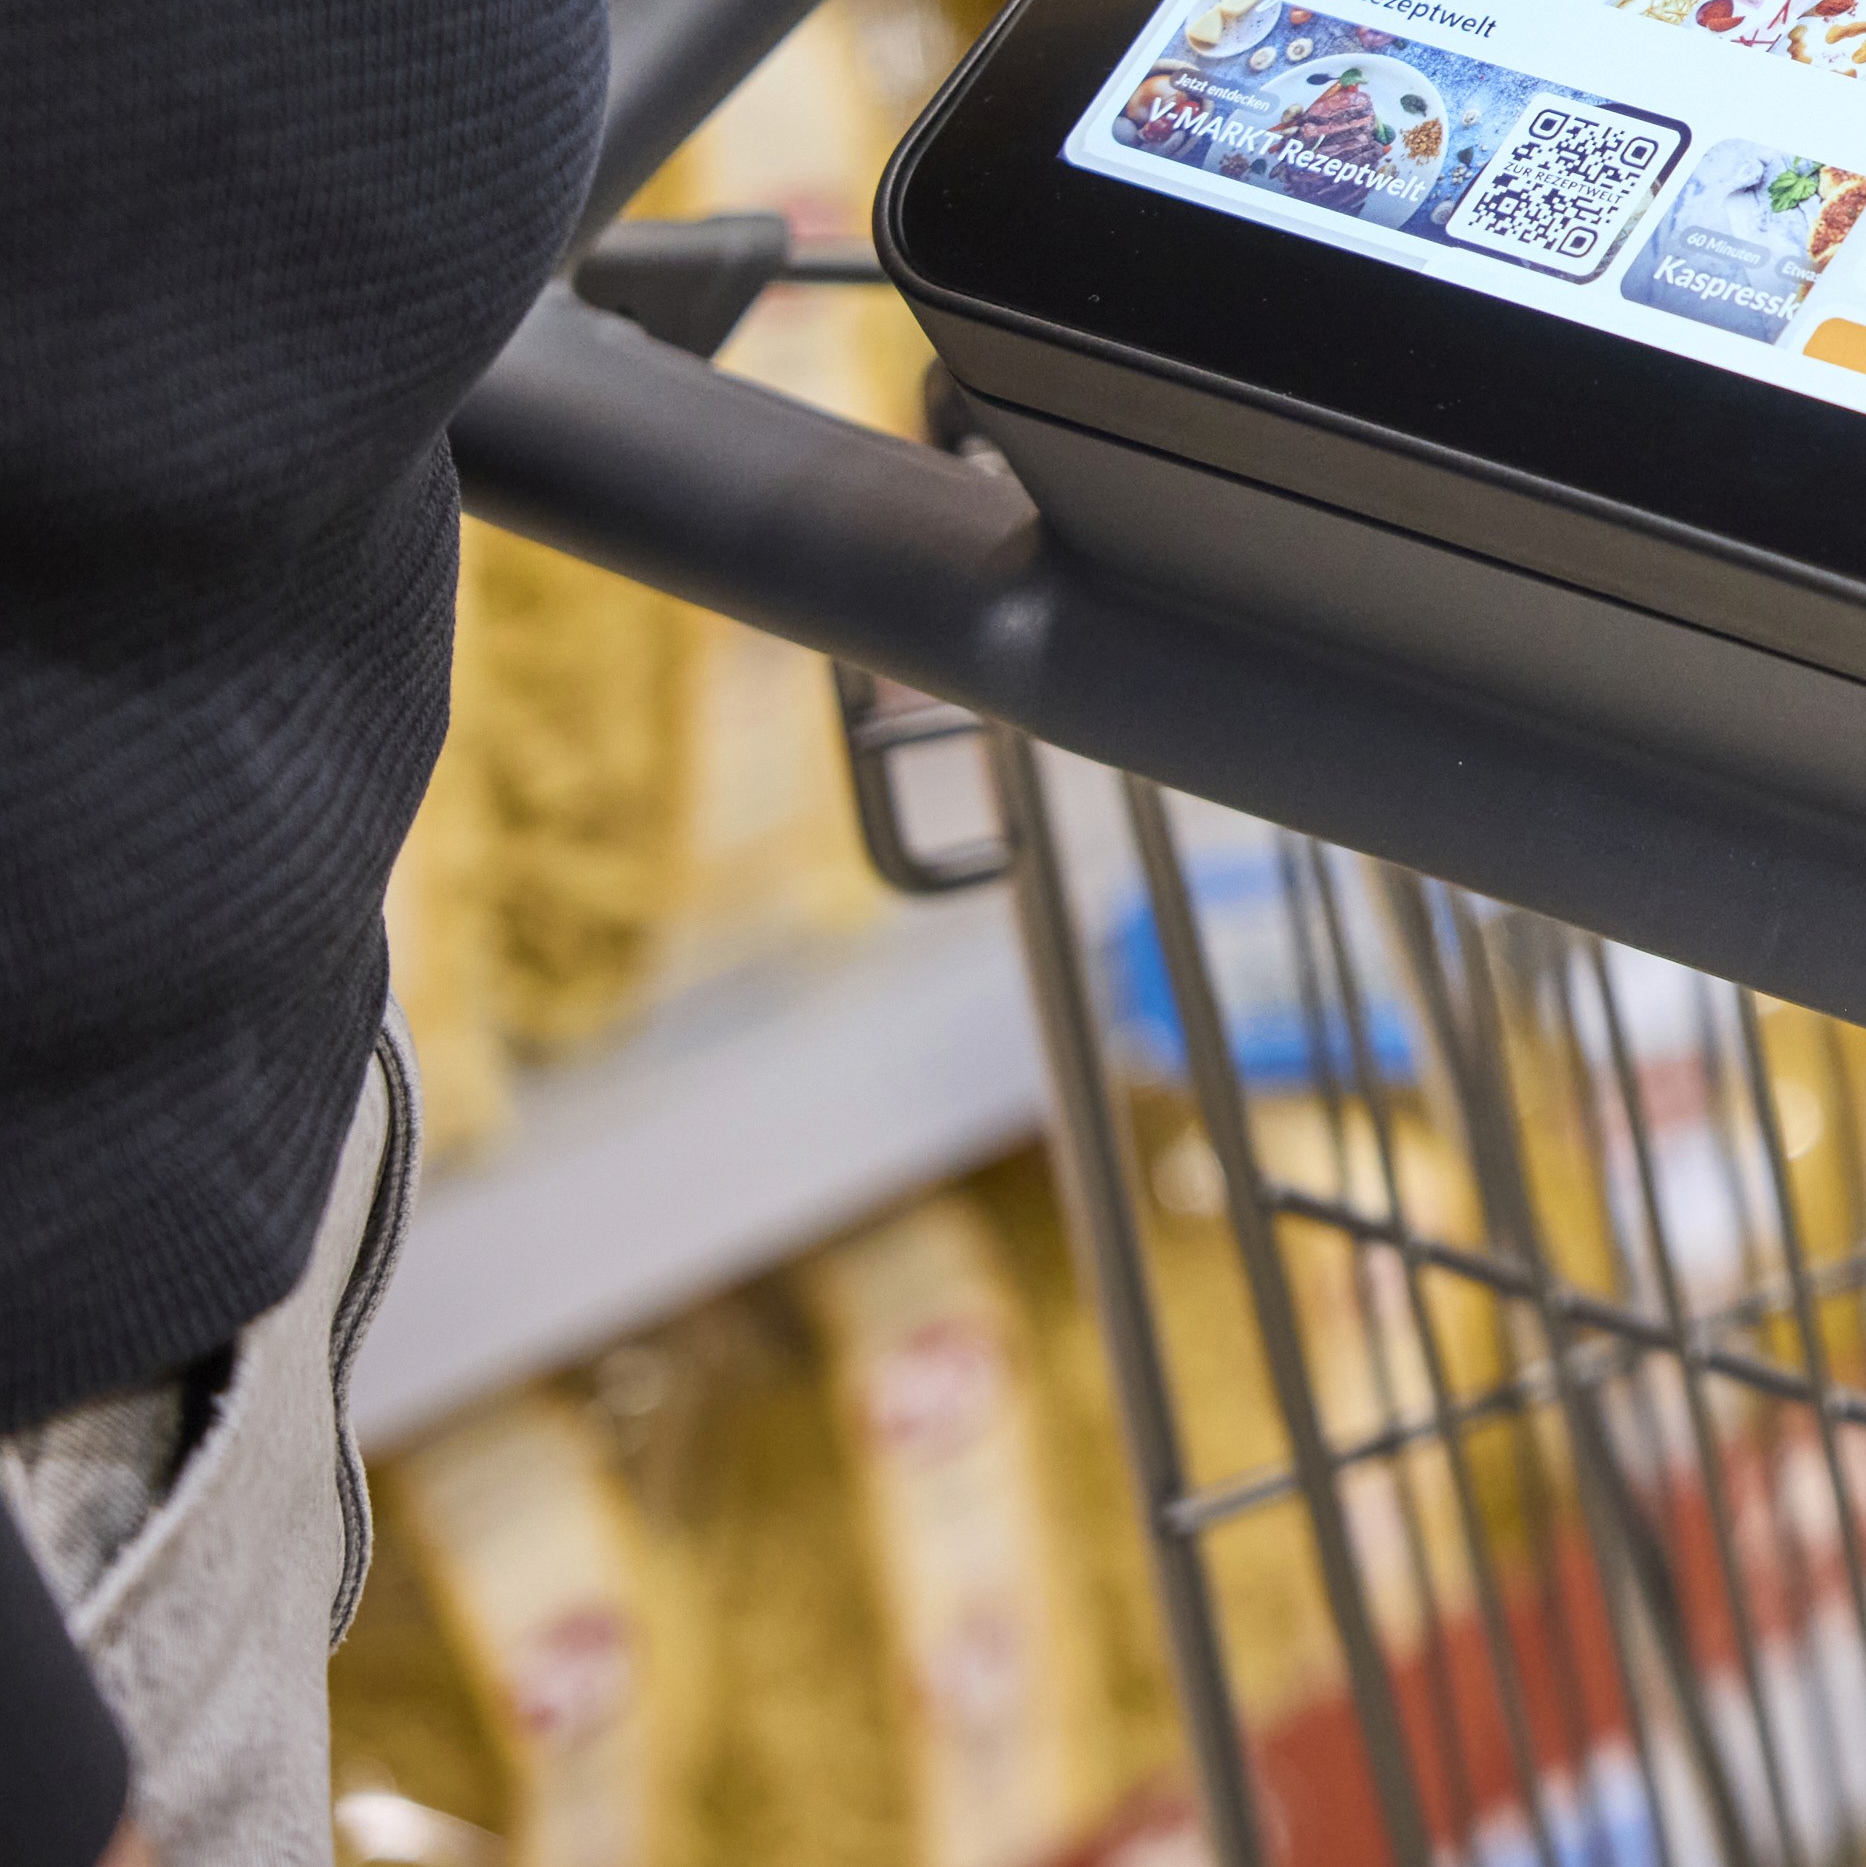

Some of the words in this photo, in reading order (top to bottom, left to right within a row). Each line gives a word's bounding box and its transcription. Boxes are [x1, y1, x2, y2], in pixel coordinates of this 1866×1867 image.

[1174, 71, 1207, 95] Jetzt
[1205, 81, 1271, 113] entdecken
[1148, 96, 1283, 156] V-MARKT
[1279, 136, 1427, 202] Rezeptwelt
[1502, 160, 1534, 179] ZUR
[1534, 168, 1625, 206] REZEPTWELT
[1686, 232, 1706, 249] 60
[1705, 234, 1762, 266] Minuten
